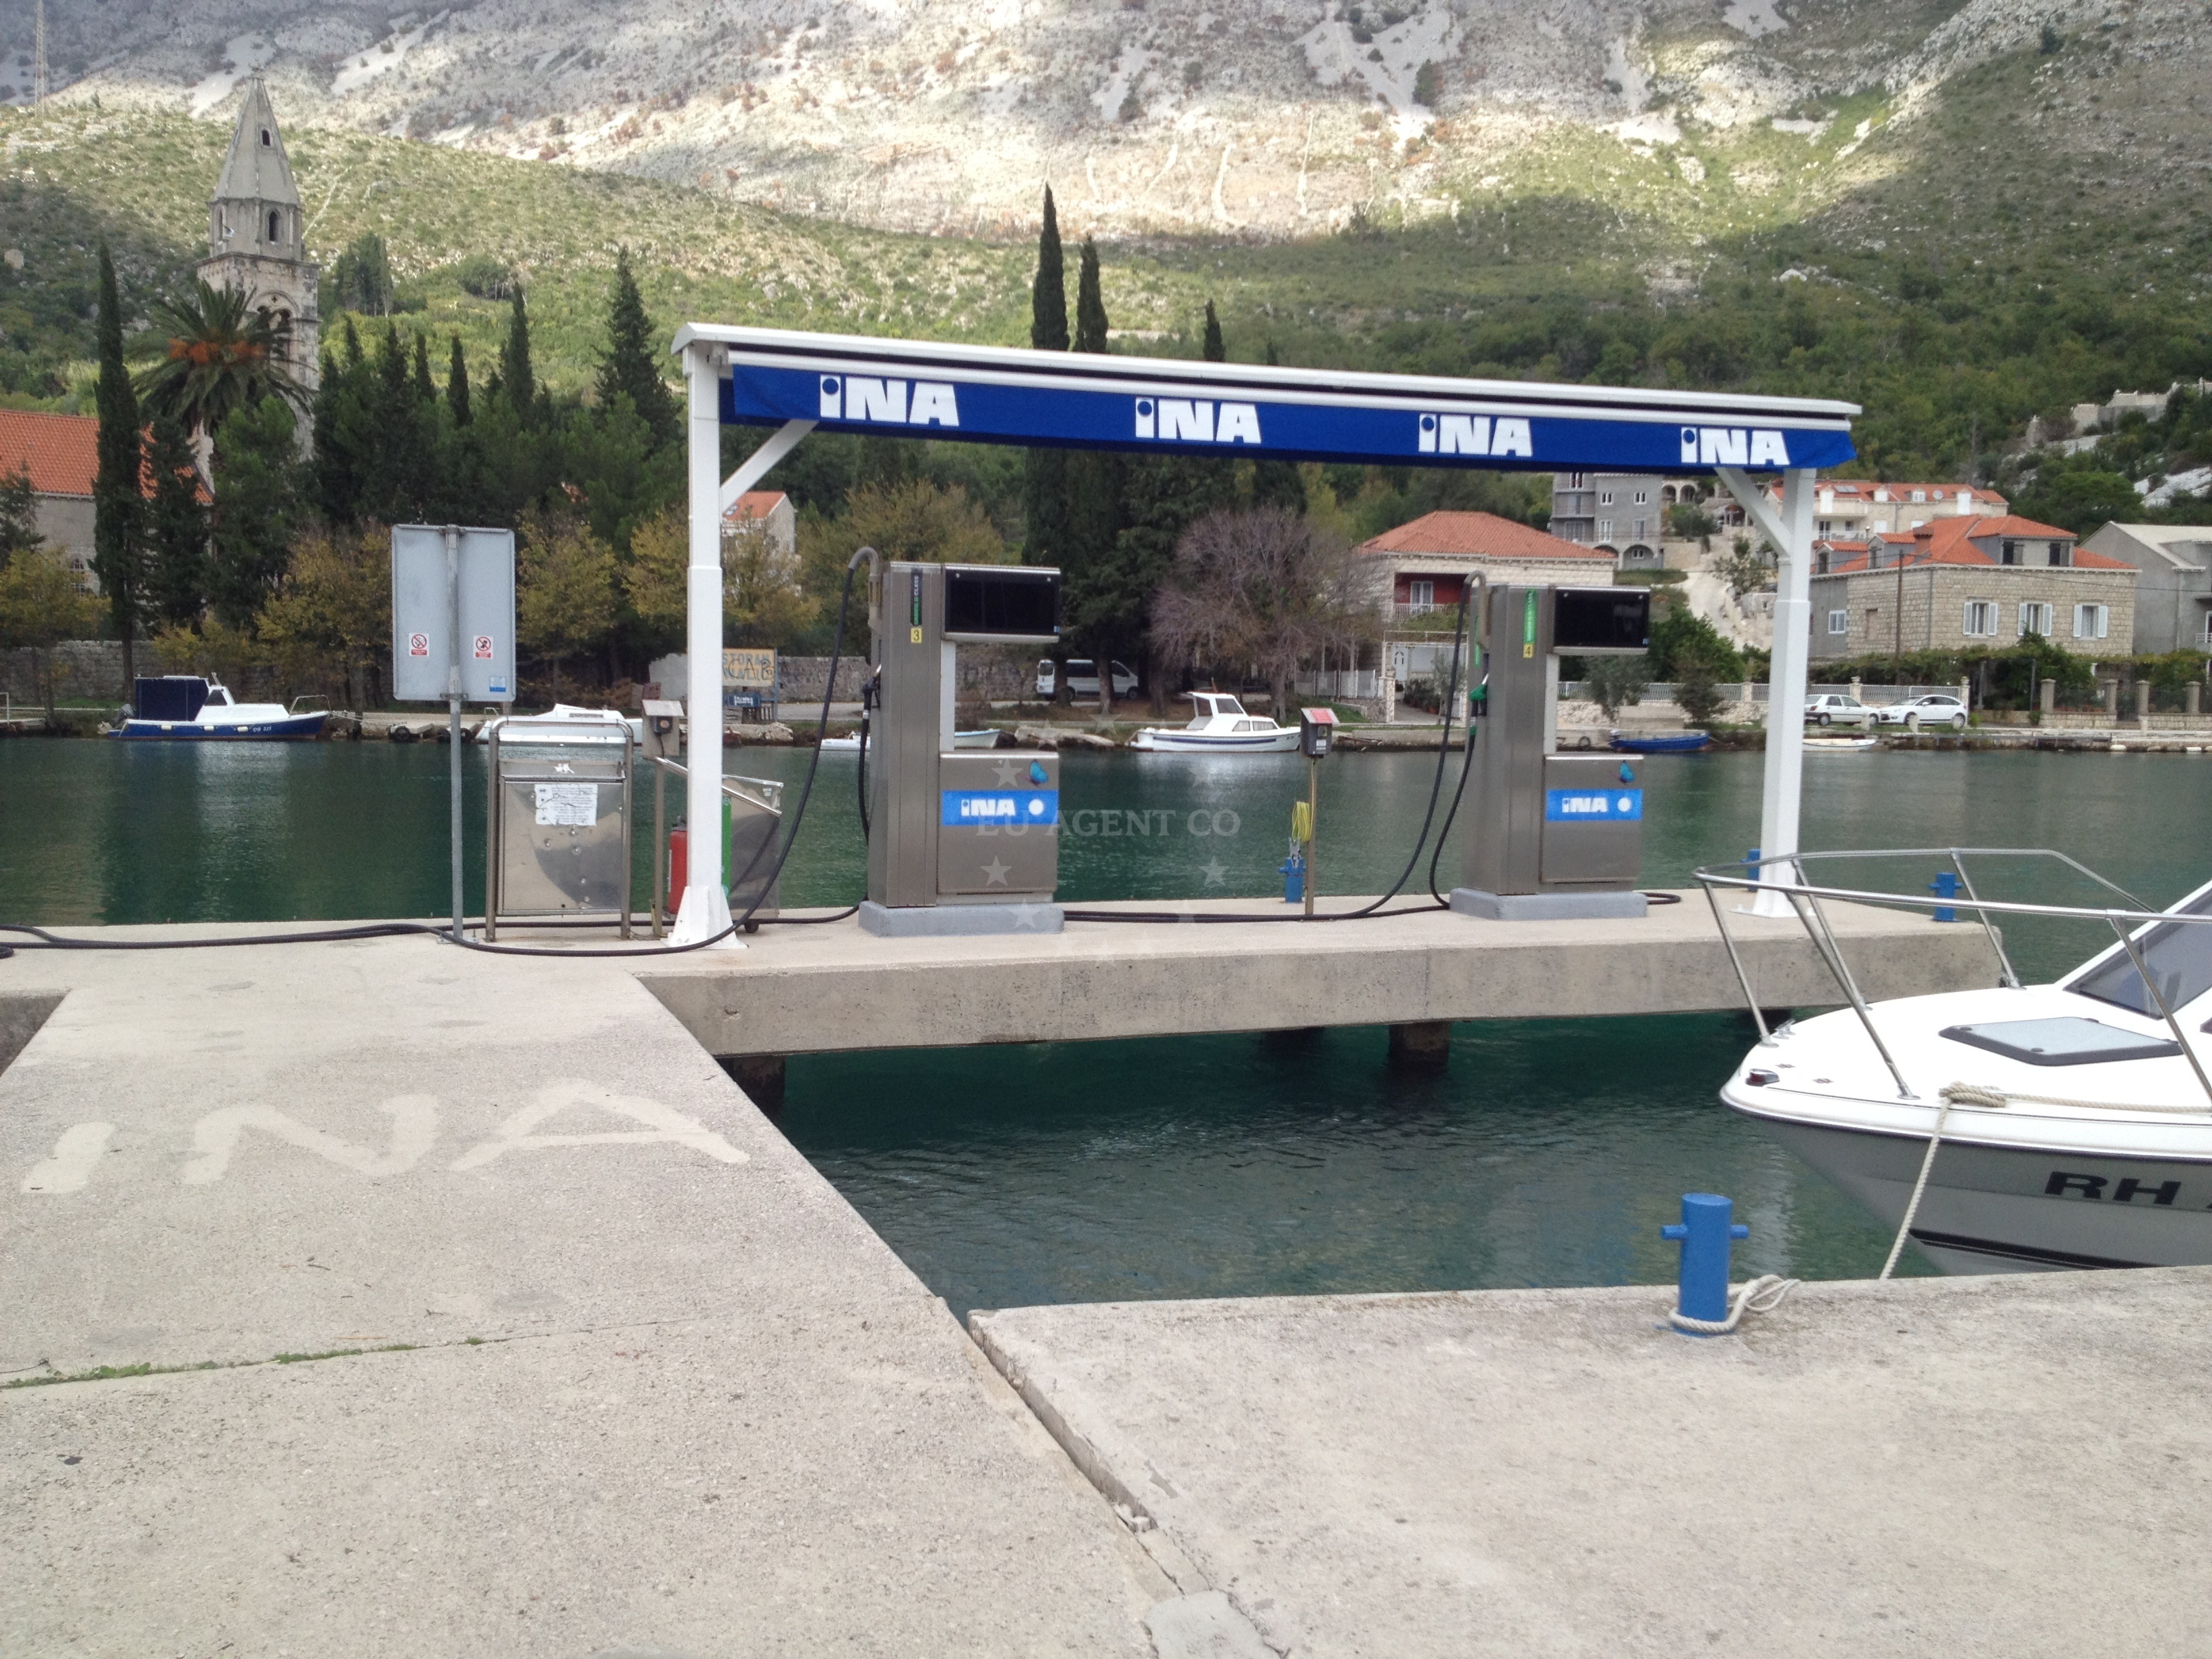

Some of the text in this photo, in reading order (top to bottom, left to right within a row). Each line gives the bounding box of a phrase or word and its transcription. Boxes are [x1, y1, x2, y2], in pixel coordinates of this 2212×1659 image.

[914, 630, 919, 641] 3
[722, 653, 770, 665] STORAN
[19, 1078, 751, 1195] INA
[2044, 1171, 2182, 1206] RH
